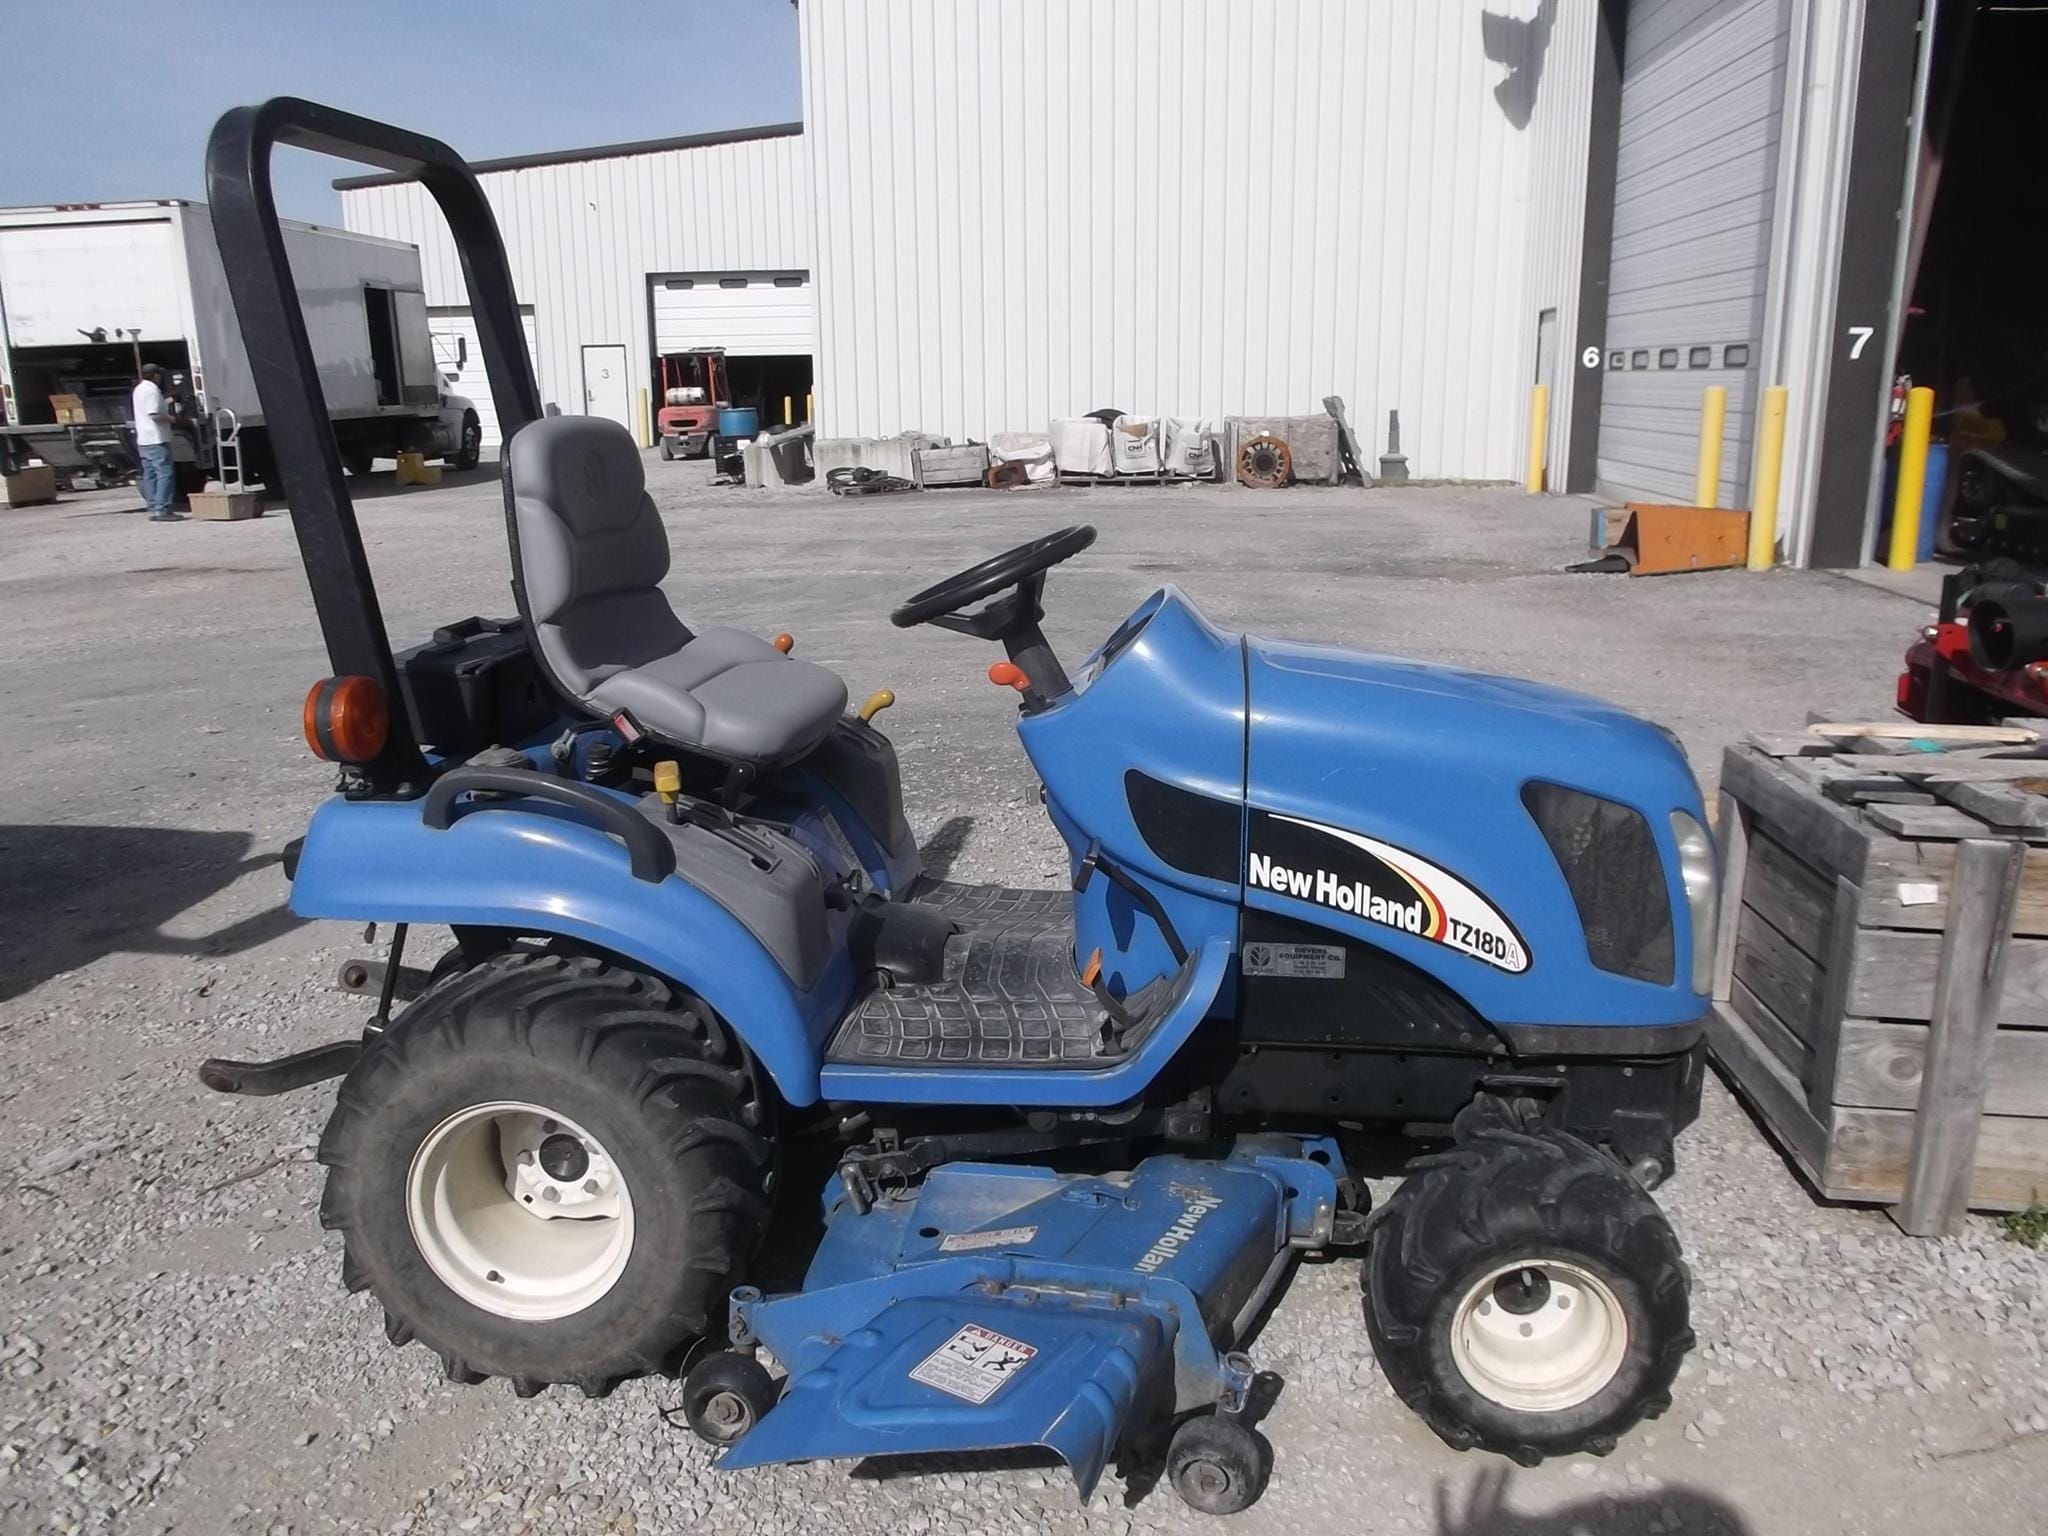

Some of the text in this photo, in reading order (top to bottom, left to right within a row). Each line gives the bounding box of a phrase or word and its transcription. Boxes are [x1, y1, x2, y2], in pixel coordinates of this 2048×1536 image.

[1582, 346, 1600, 368] 6
[1848, 326, 1874, 360] 7
[601, 368, 610, 380] 3
[1249, 852, 1423, 935] New Holland
[1177, 1194, 1224, 1228] New
[984, 1333, 1028, 1353] DANGER
